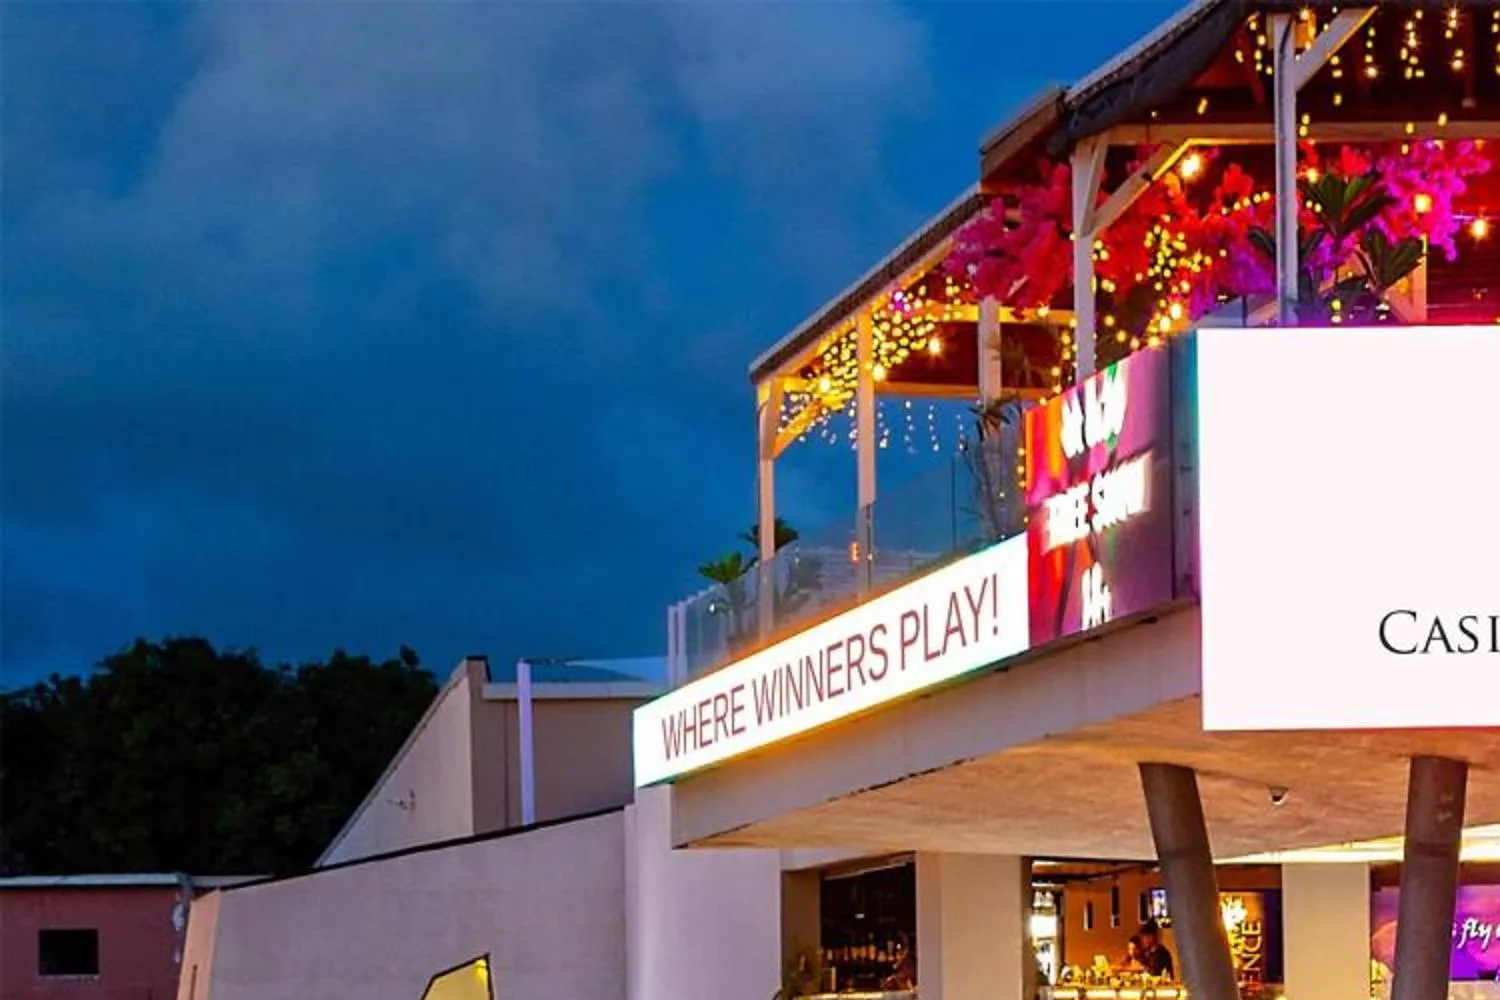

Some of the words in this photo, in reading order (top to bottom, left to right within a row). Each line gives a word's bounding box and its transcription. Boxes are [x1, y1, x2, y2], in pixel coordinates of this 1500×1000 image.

[661, 684, 745, 760] WHERE
[752, 622, 889, 726] WINNERS
[900, 573, 999, 671] PLAY!
[1457, 917, 1492, 949] fly
